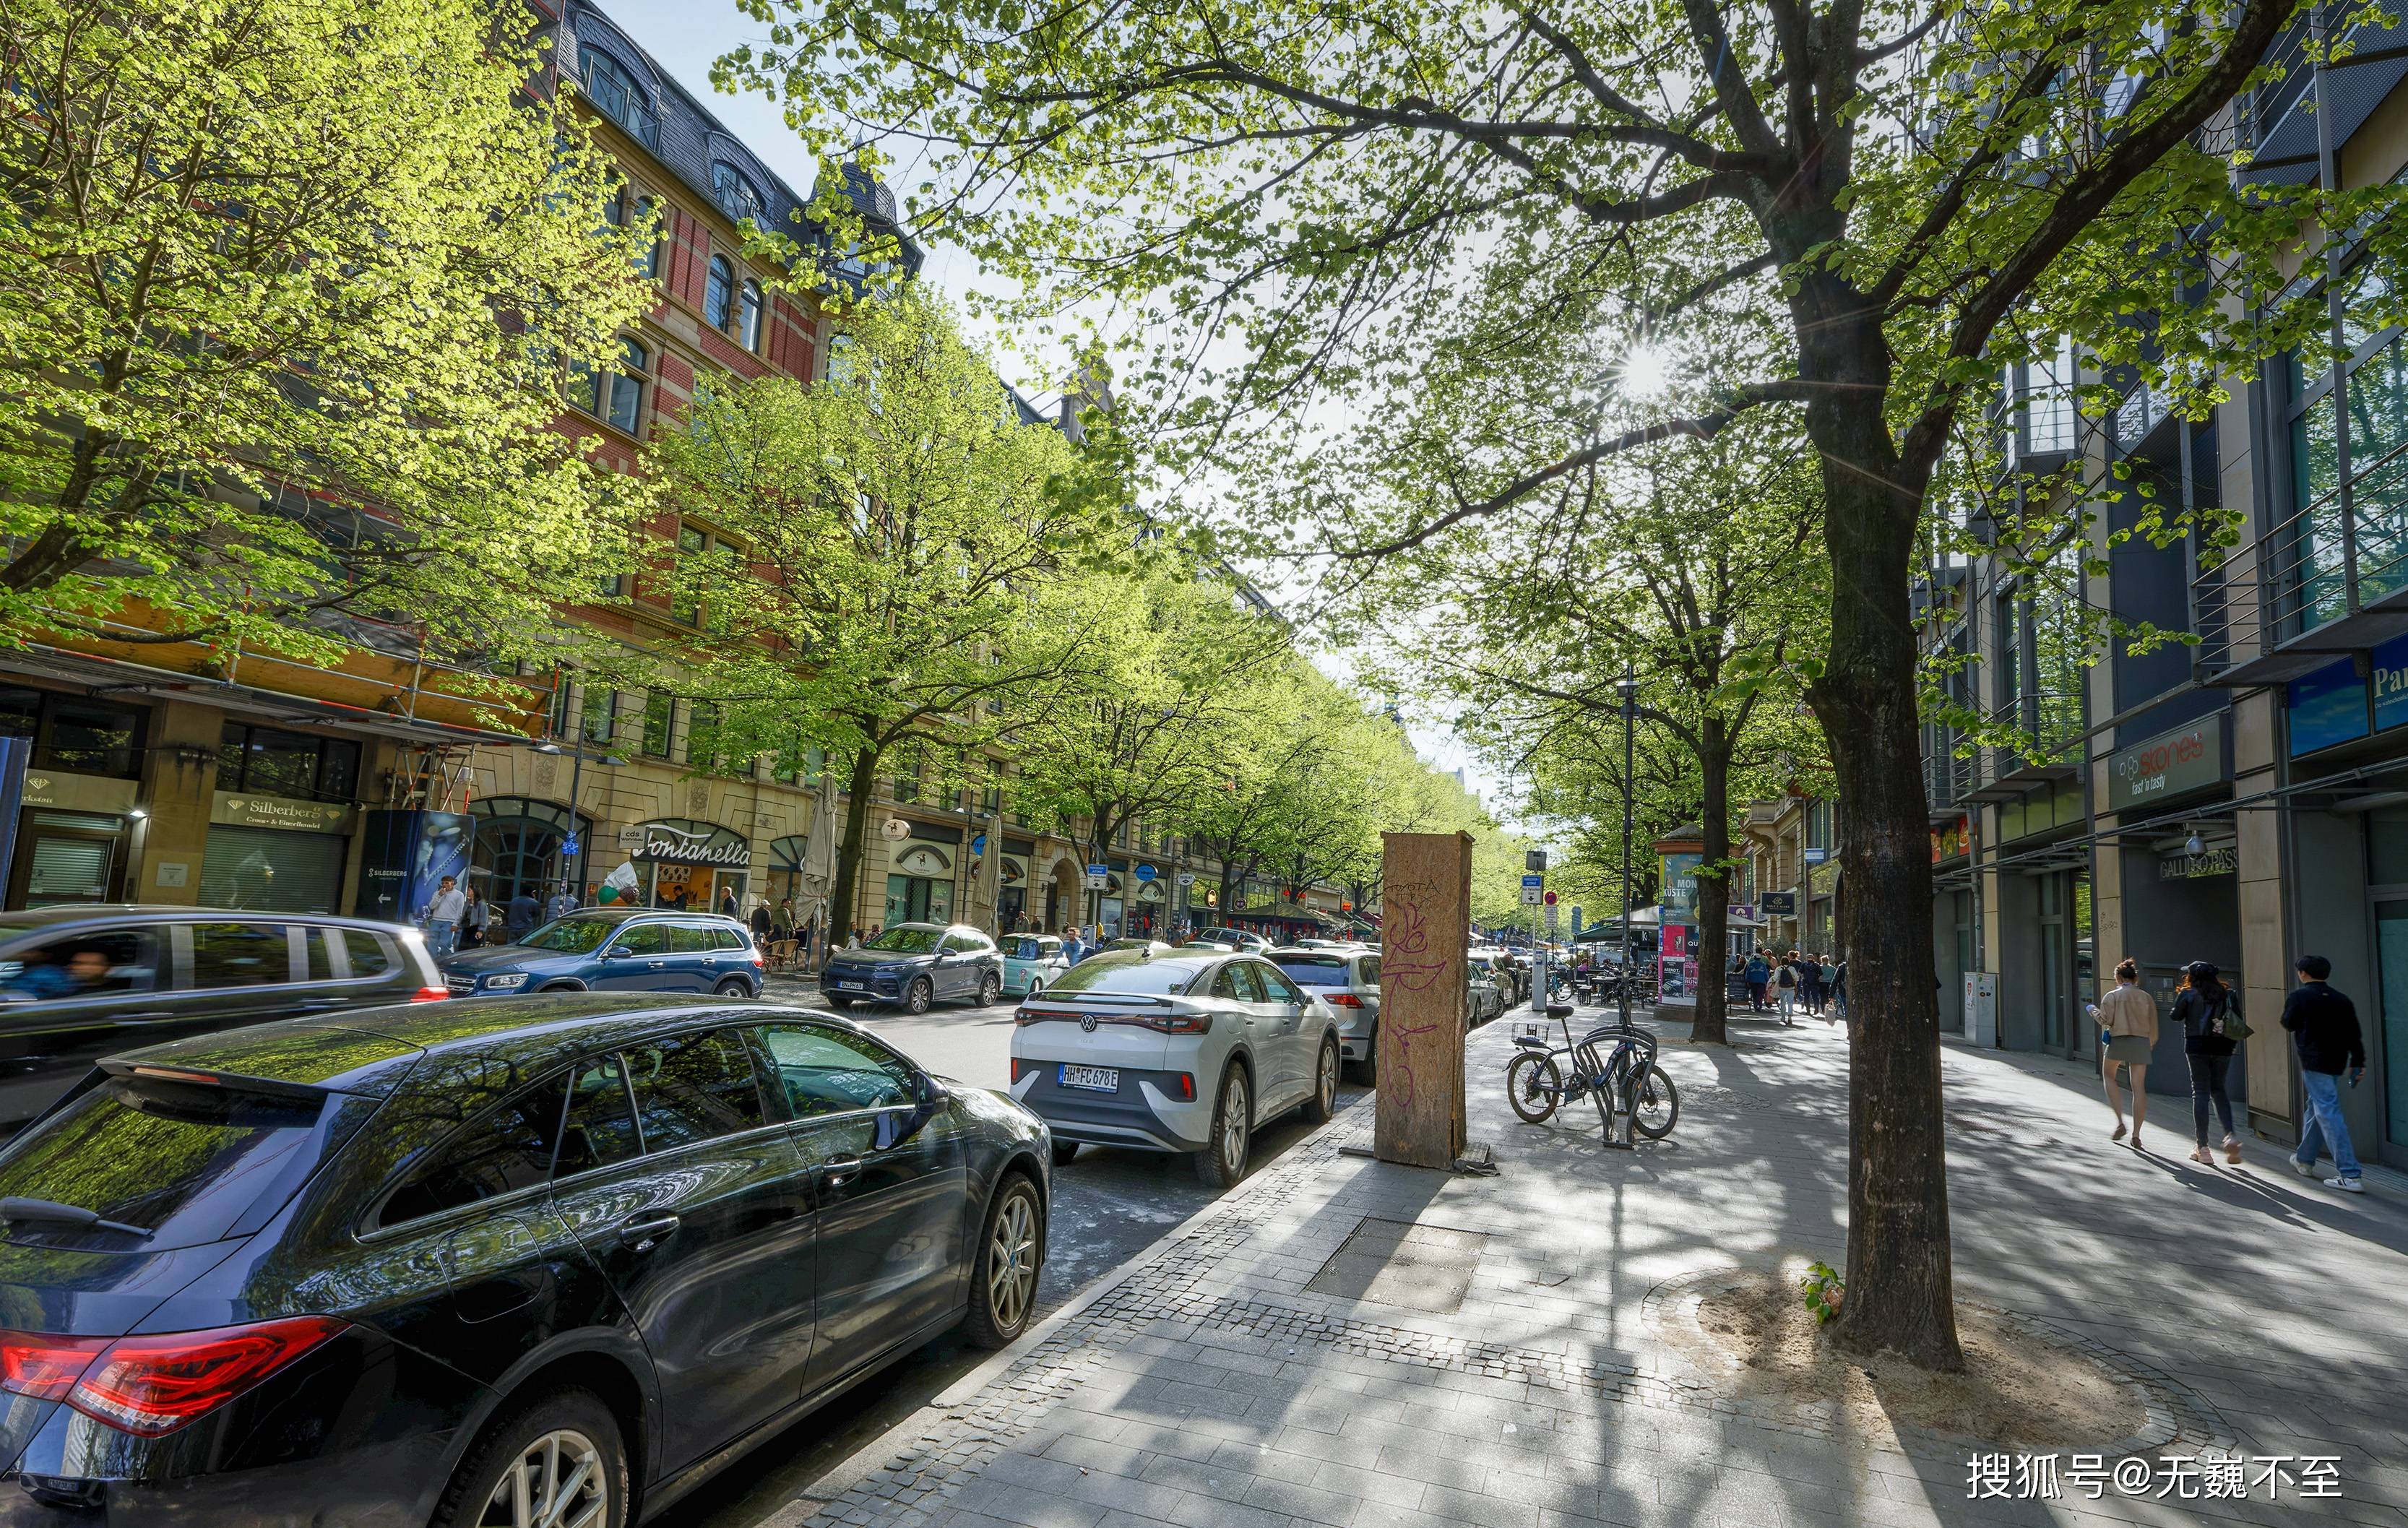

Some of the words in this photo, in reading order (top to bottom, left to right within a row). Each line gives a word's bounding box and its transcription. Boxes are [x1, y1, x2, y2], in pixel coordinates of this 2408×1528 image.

[2132, 780, 2144, 795] fast
[2150, 774, 2166, 790] tasty
[249, 800, 322, 819] Silberberg
[1384, 879, 1442, 895] TOYOTA
